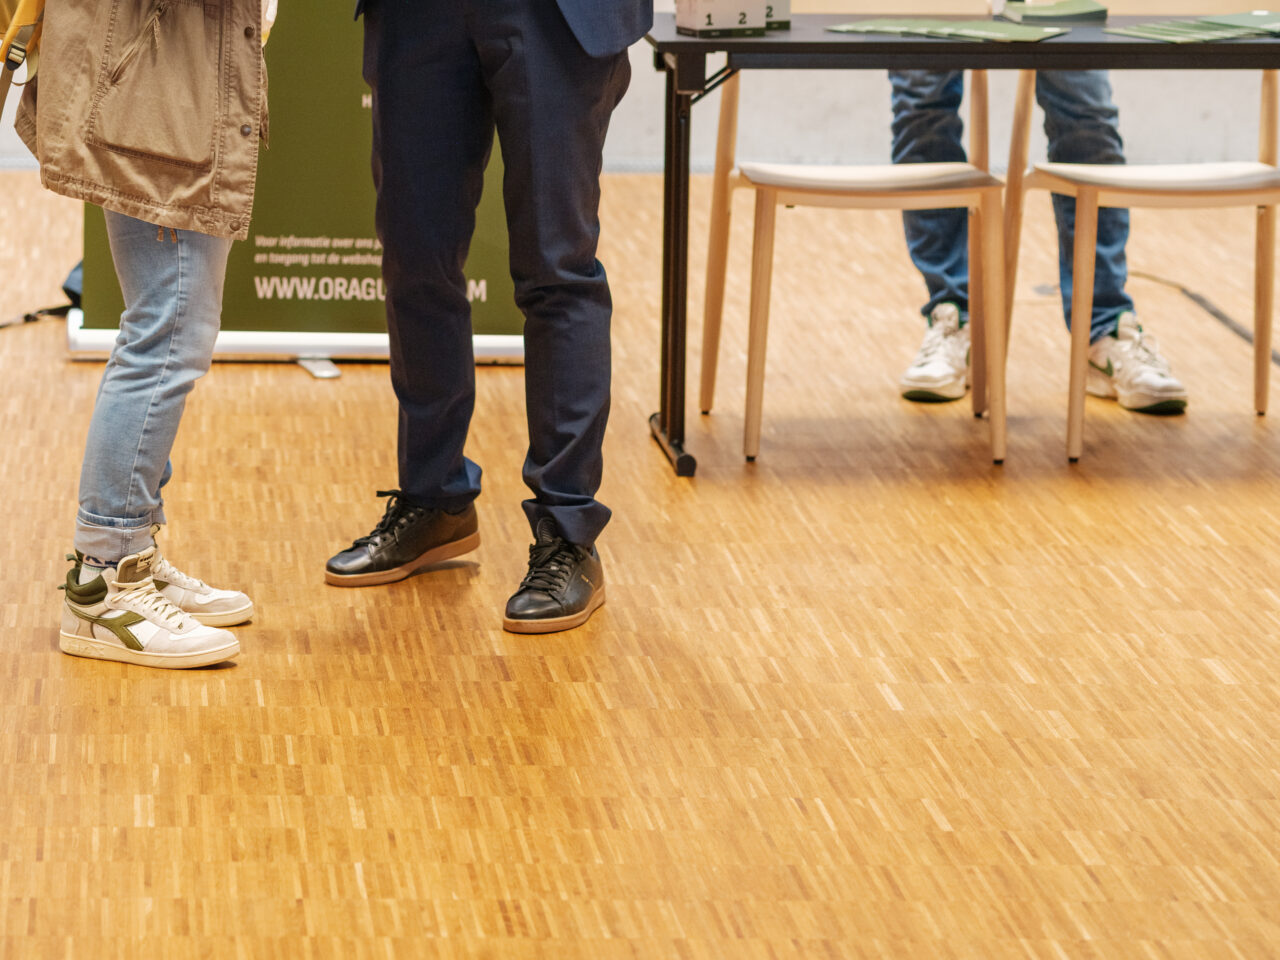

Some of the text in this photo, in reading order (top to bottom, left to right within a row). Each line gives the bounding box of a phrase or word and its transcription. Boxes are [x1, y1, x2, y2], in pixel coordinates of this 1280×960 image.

[705, 12, 747, 26] 1 2
[279, 235, 330, 250] informatie
[269, 253, 309, 266] toegang
